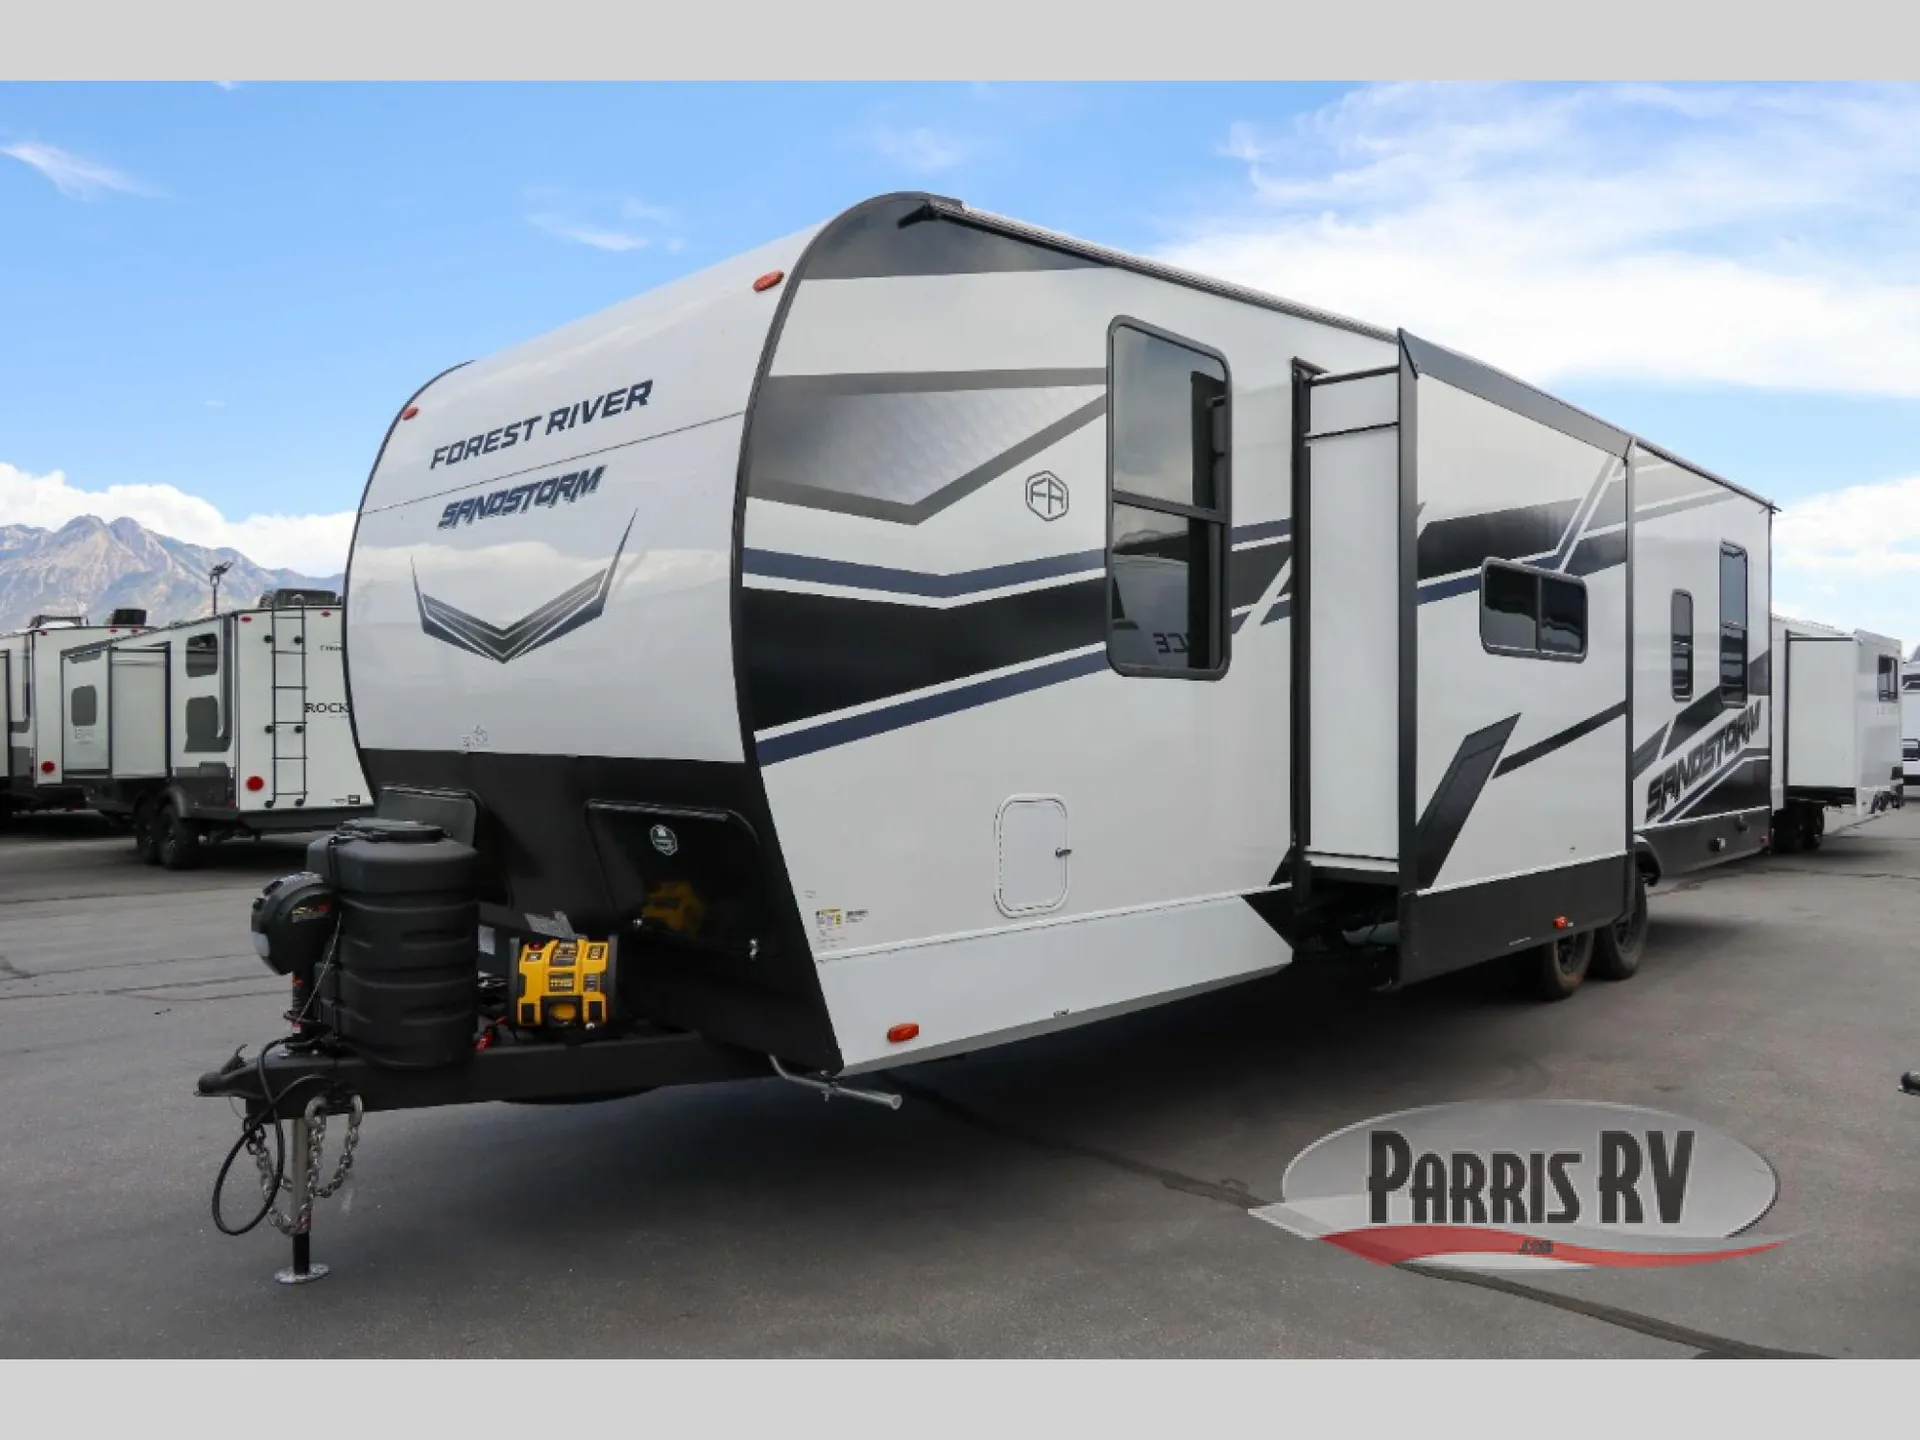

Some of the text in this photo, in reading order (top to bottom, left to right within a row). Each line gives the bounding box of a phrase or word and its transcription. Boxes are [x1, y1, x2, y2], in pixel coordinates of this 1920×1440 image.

[430, 379, 653, 469] FOREST RIVER
[437, 465, 607, 529] SANDSTORM
[1645, 699, 1761, 823] SANDSTORM
